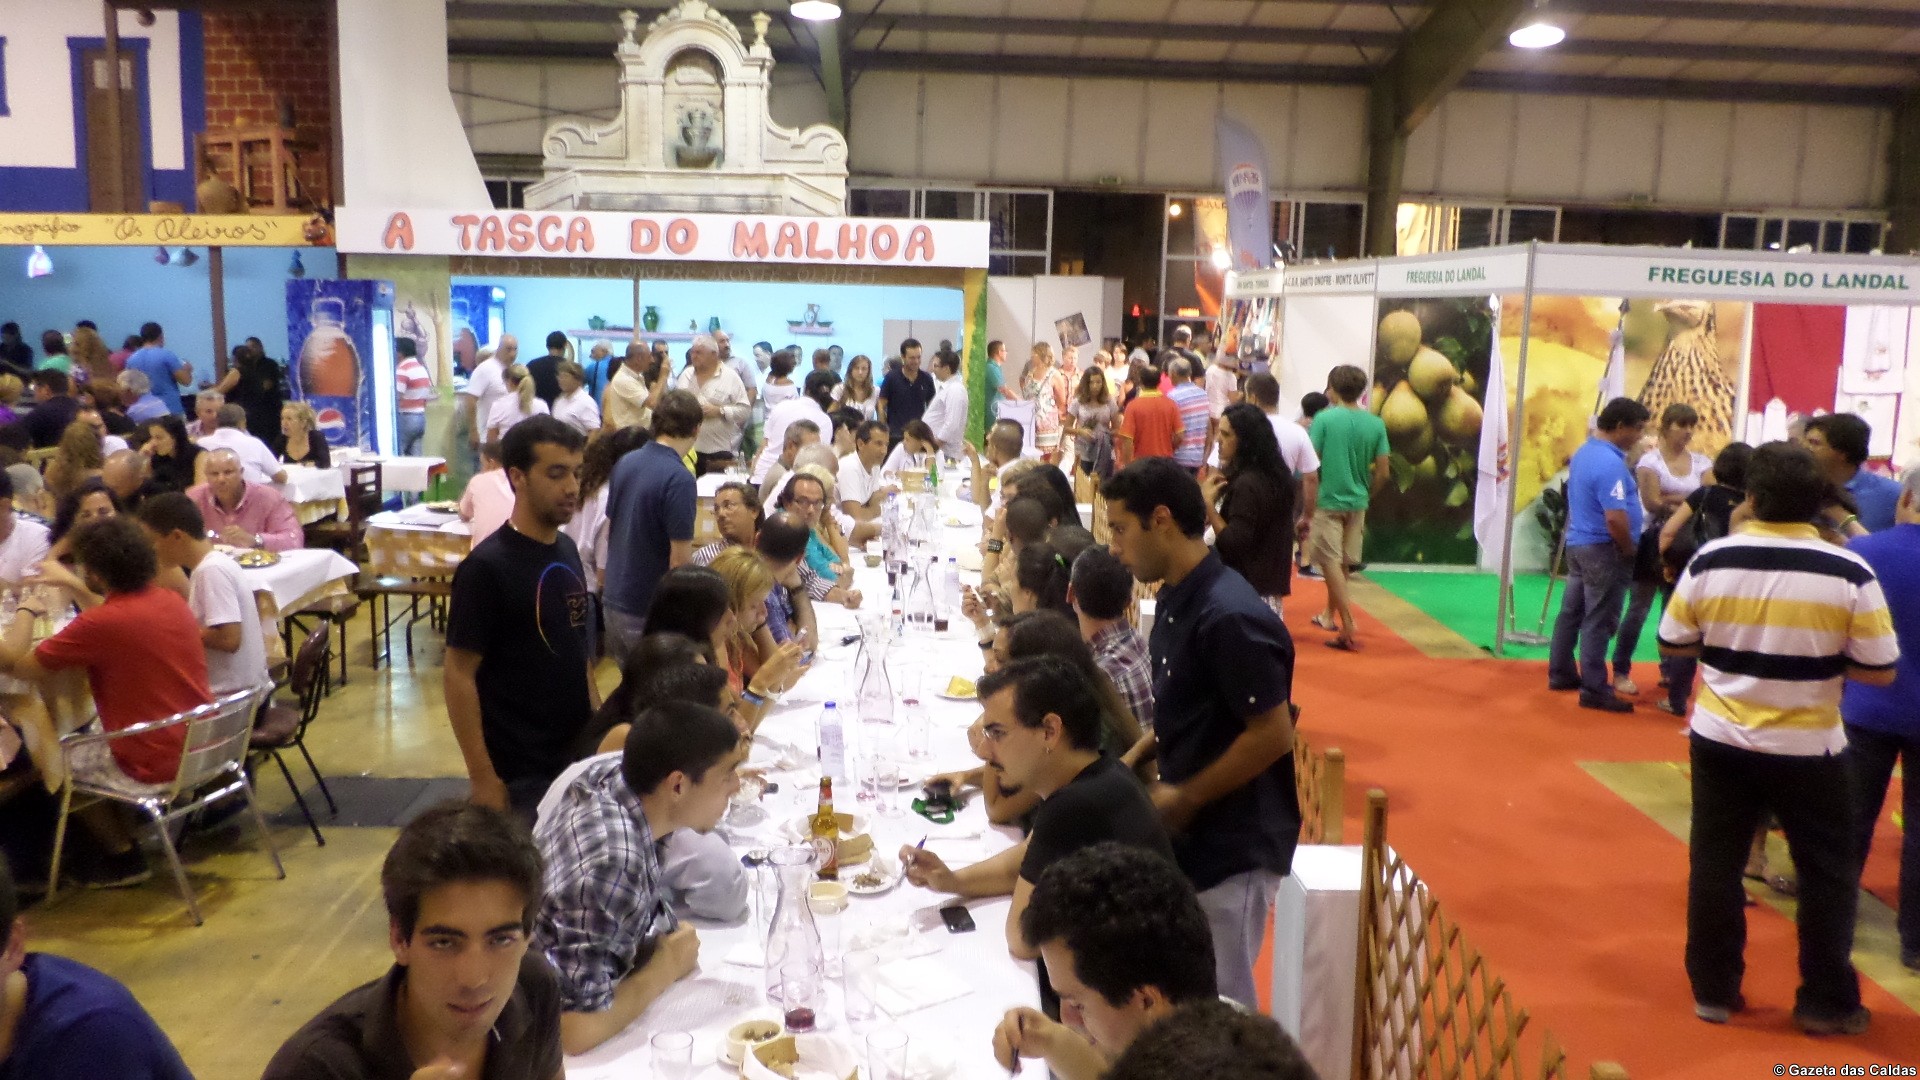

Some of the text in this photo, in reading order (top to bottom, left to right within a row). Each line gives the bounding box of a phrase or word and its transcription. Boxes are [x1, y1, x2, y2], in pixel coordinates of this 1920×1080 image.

[155, 216, 278, 242] Oleiros"
[384, 211, 935, 262] A TASCA DO MALHOA
[1406, 266, 1486, 284] FREGUESIA DO LANDAL
[1648, 265, 1909, 290] FREGUESIA DO LANDAL
[1610, 480, 1624, 500] 4
